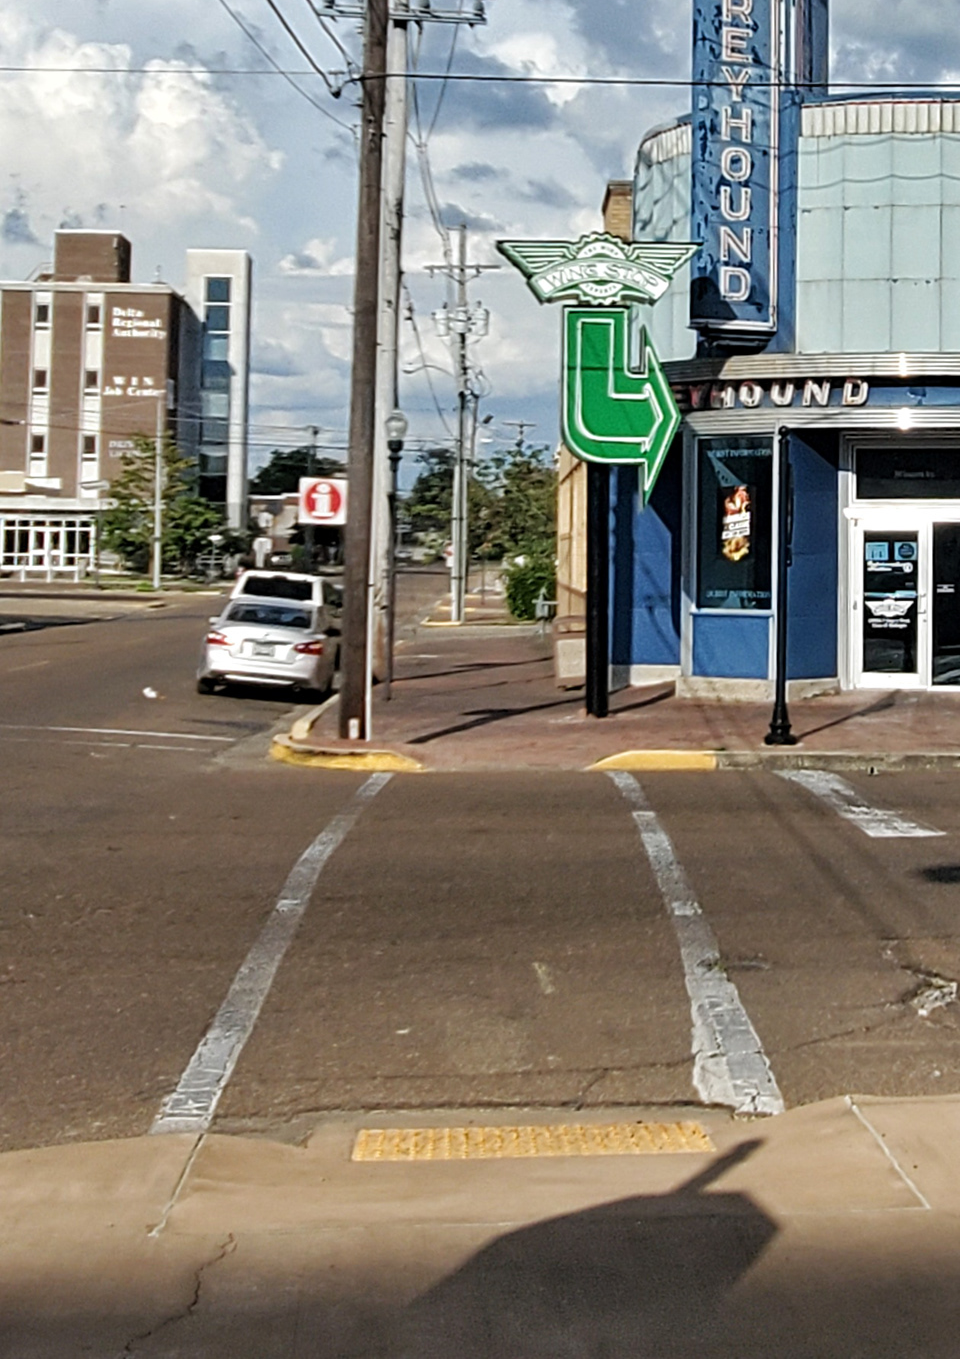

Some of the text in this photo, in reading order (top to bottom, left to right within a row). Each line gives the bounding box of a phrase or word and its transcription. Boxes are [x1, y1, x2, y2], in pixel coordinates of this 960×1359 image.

[112, 306, 145, 318] Delta
[112, 317, 162, 329] Regional
[112, 328, 167, 340] Authority
[103, 386, 167, 397] Job Center
